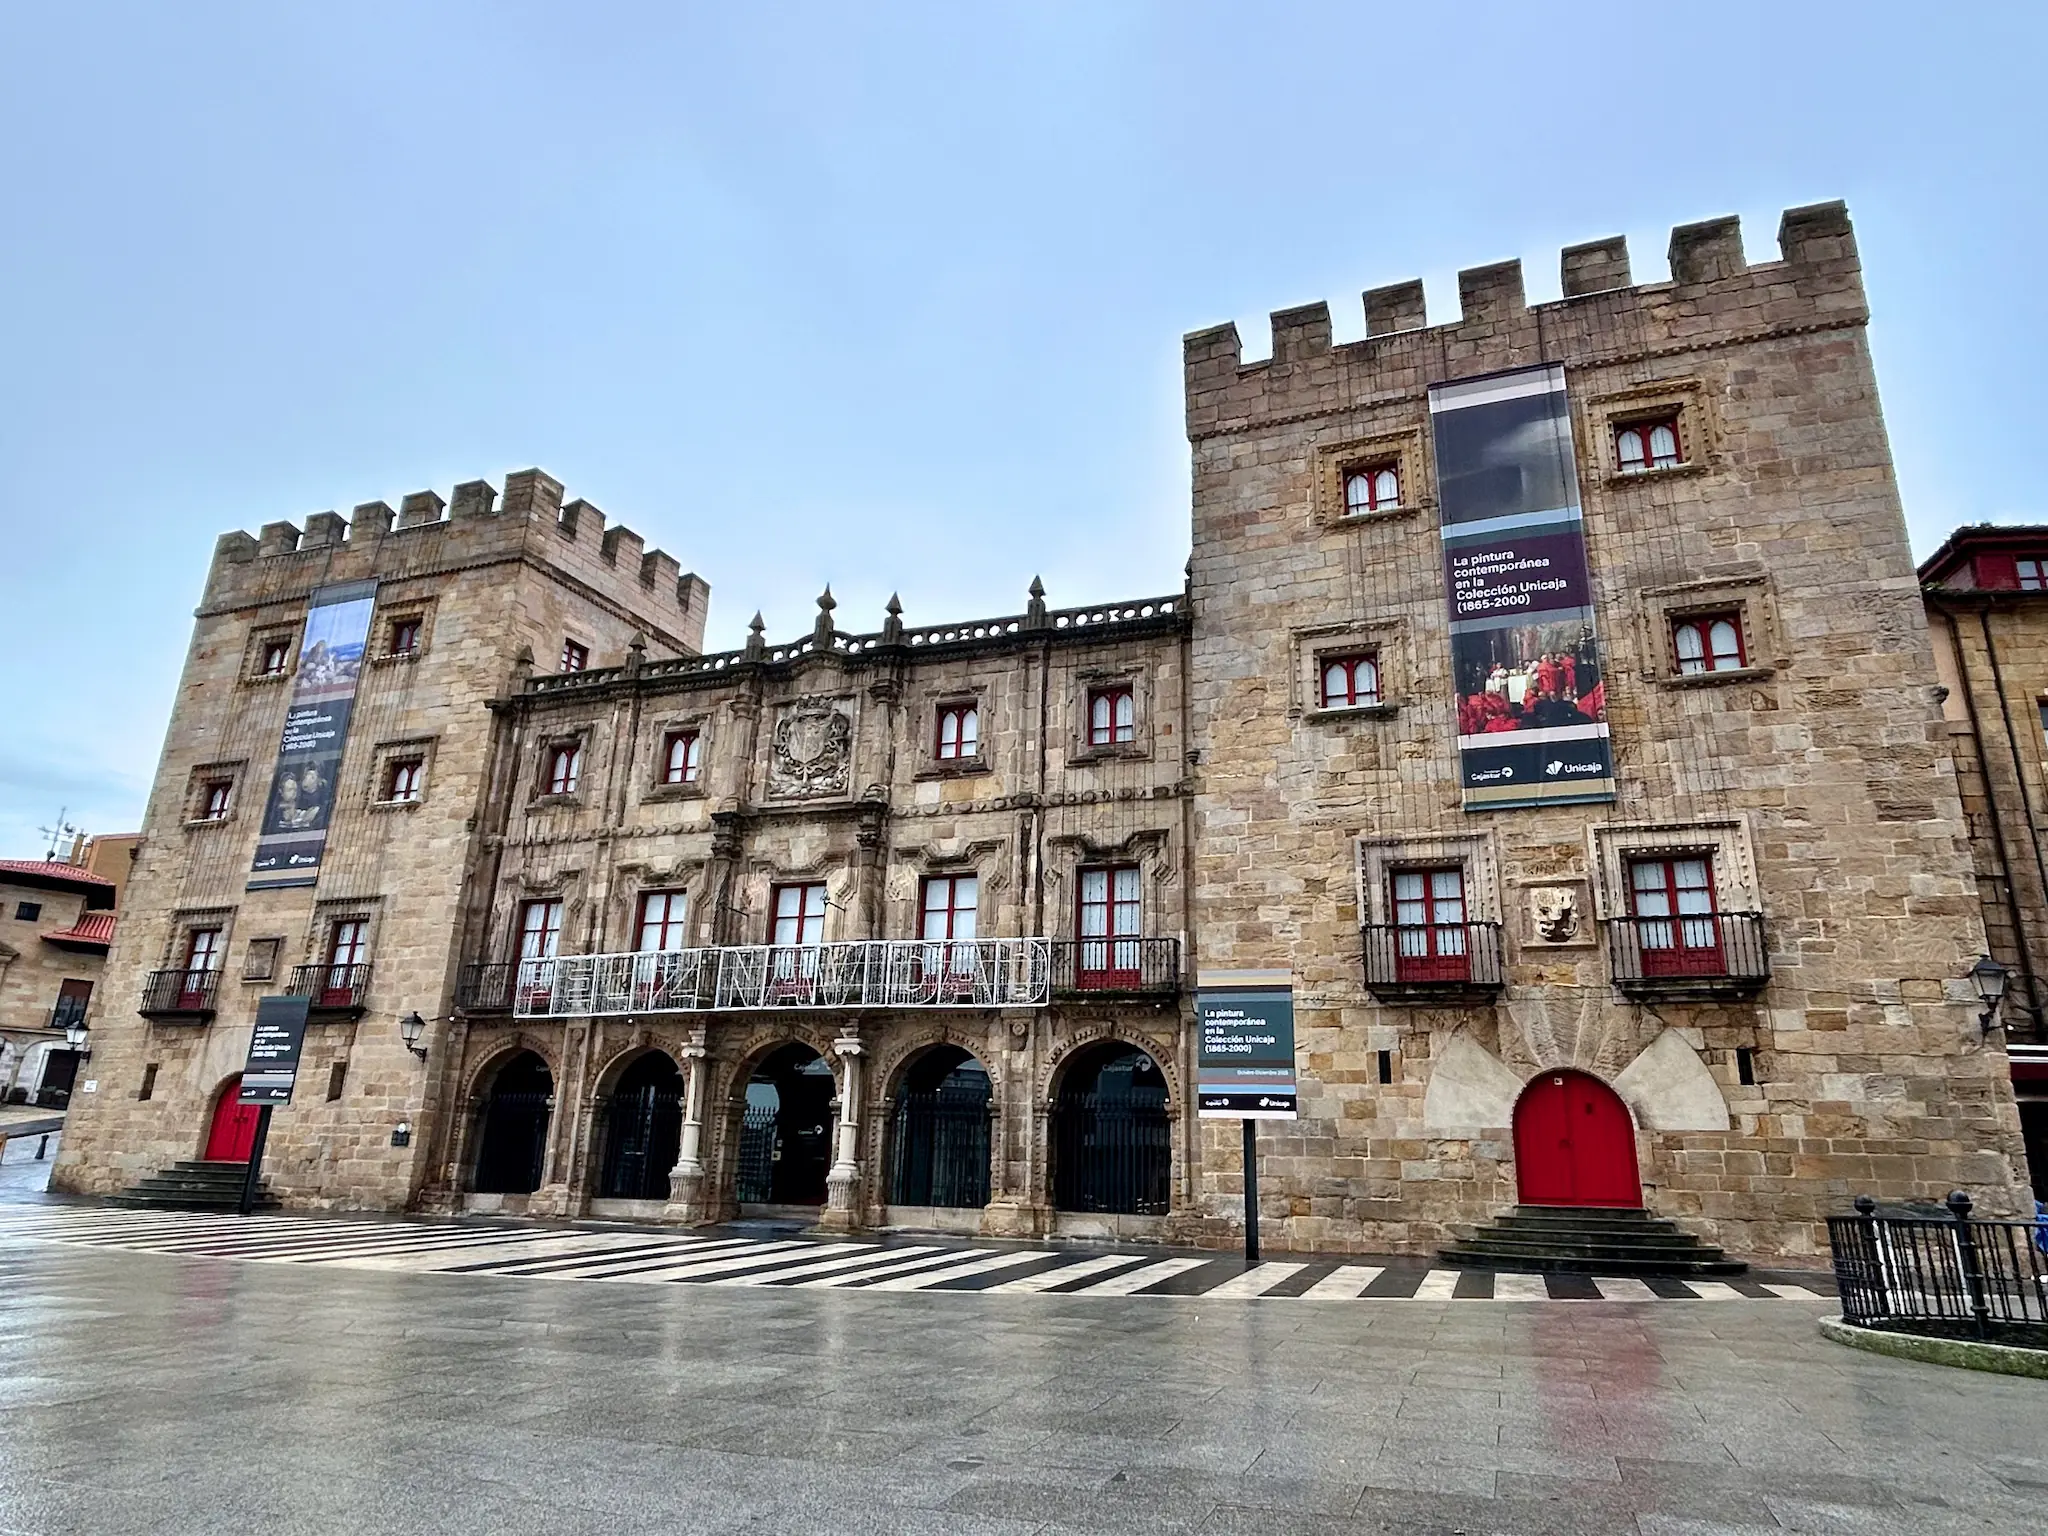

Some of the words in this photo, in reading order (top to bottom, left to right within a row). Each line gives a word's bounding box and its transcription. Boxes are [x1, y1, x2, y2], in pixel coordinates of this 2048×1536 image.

[1454, 557, 1468, 566] La
[1471, 550, 1514, 566] pintura
[1454, 558, 1550, 578] contemporánea
[1455, 580, 1470, 589] en
[1473, 577, 1484, 586] la
[1456, 584, 1517, 600] Colección
[1520, 578, 1567, 592] Unicaja
[1457, 594, 1530, 614] (1865-2000)
[1565, 762, 1602, 774] Unicaja
[1216, 1009, 1244, 1018] pintura
[1205, 1017, 1266, 1027] contemporánea
[1205, 1035, 1244, 1043] Colección
[1245, 1035, 1276, 1045] Unicaja
[1205, 1044, 1252, 1053] (1865-2000)
[1102, 1064, 1134, 1073] Cajastur
